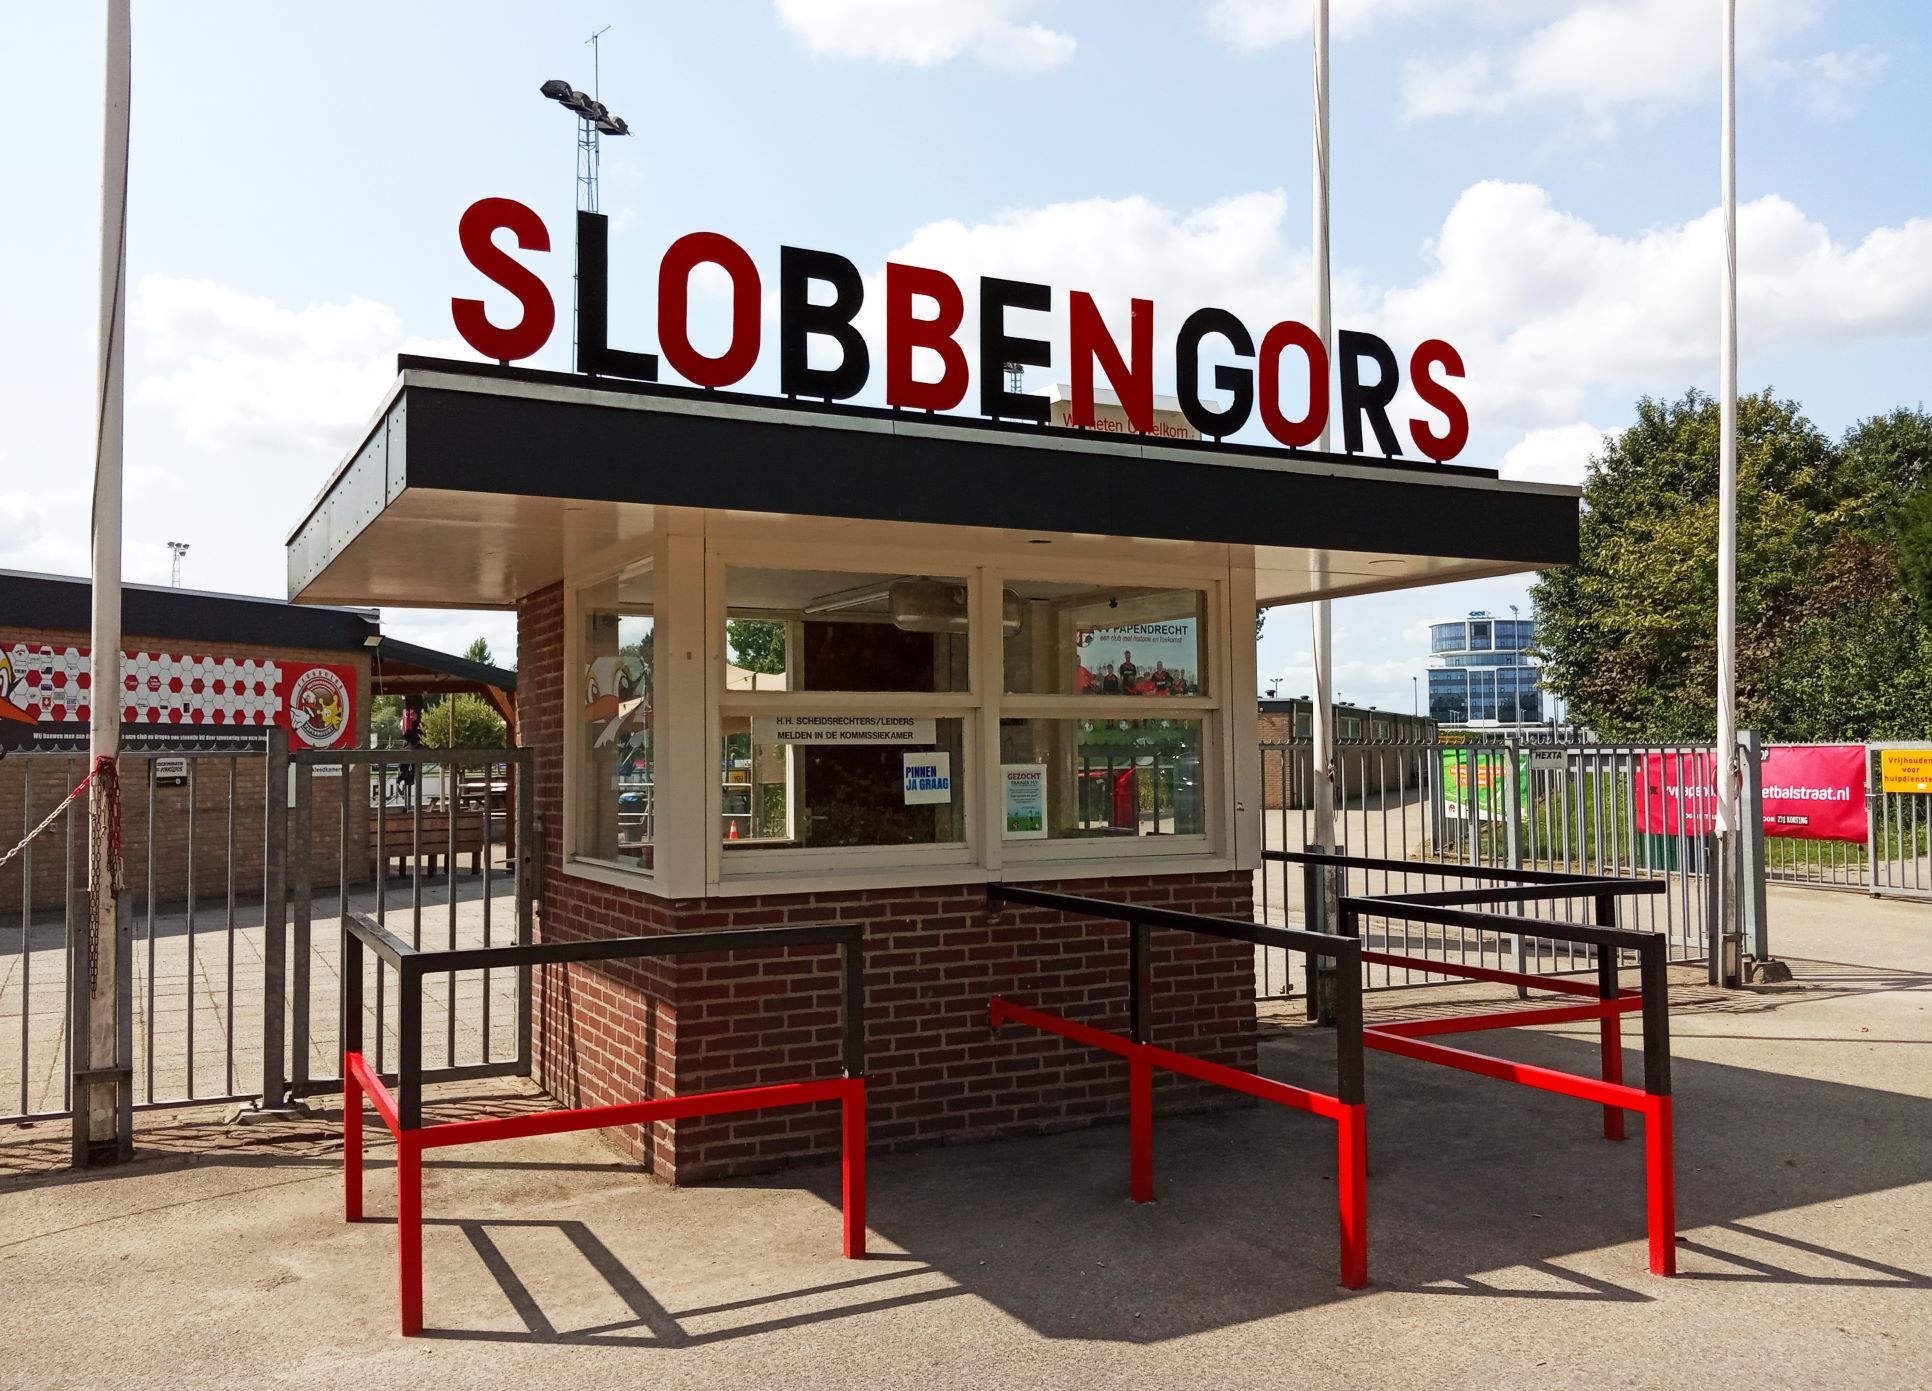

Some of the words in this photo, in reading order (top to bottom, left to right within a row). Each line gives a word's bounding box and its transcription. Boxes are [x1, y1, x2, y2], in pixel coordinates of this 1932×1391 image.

[451, 197, 1468, 461] SLOBBENGORS
[1149, 423, 1188, 438] elkom
[777, 717, 793, 725] H.H.
[797, 717, 914, 726] SCHEIDSRECHTERS/LEIDERS
[1535, 751, 1562, 760] HEXTA
[1888, 757, 1932, 765] Vrijhouden
[906, 766, 936, 778] PINNEN
[906, 779, 917, 791] JA
[920, 778, 949, 790] GRAAG
